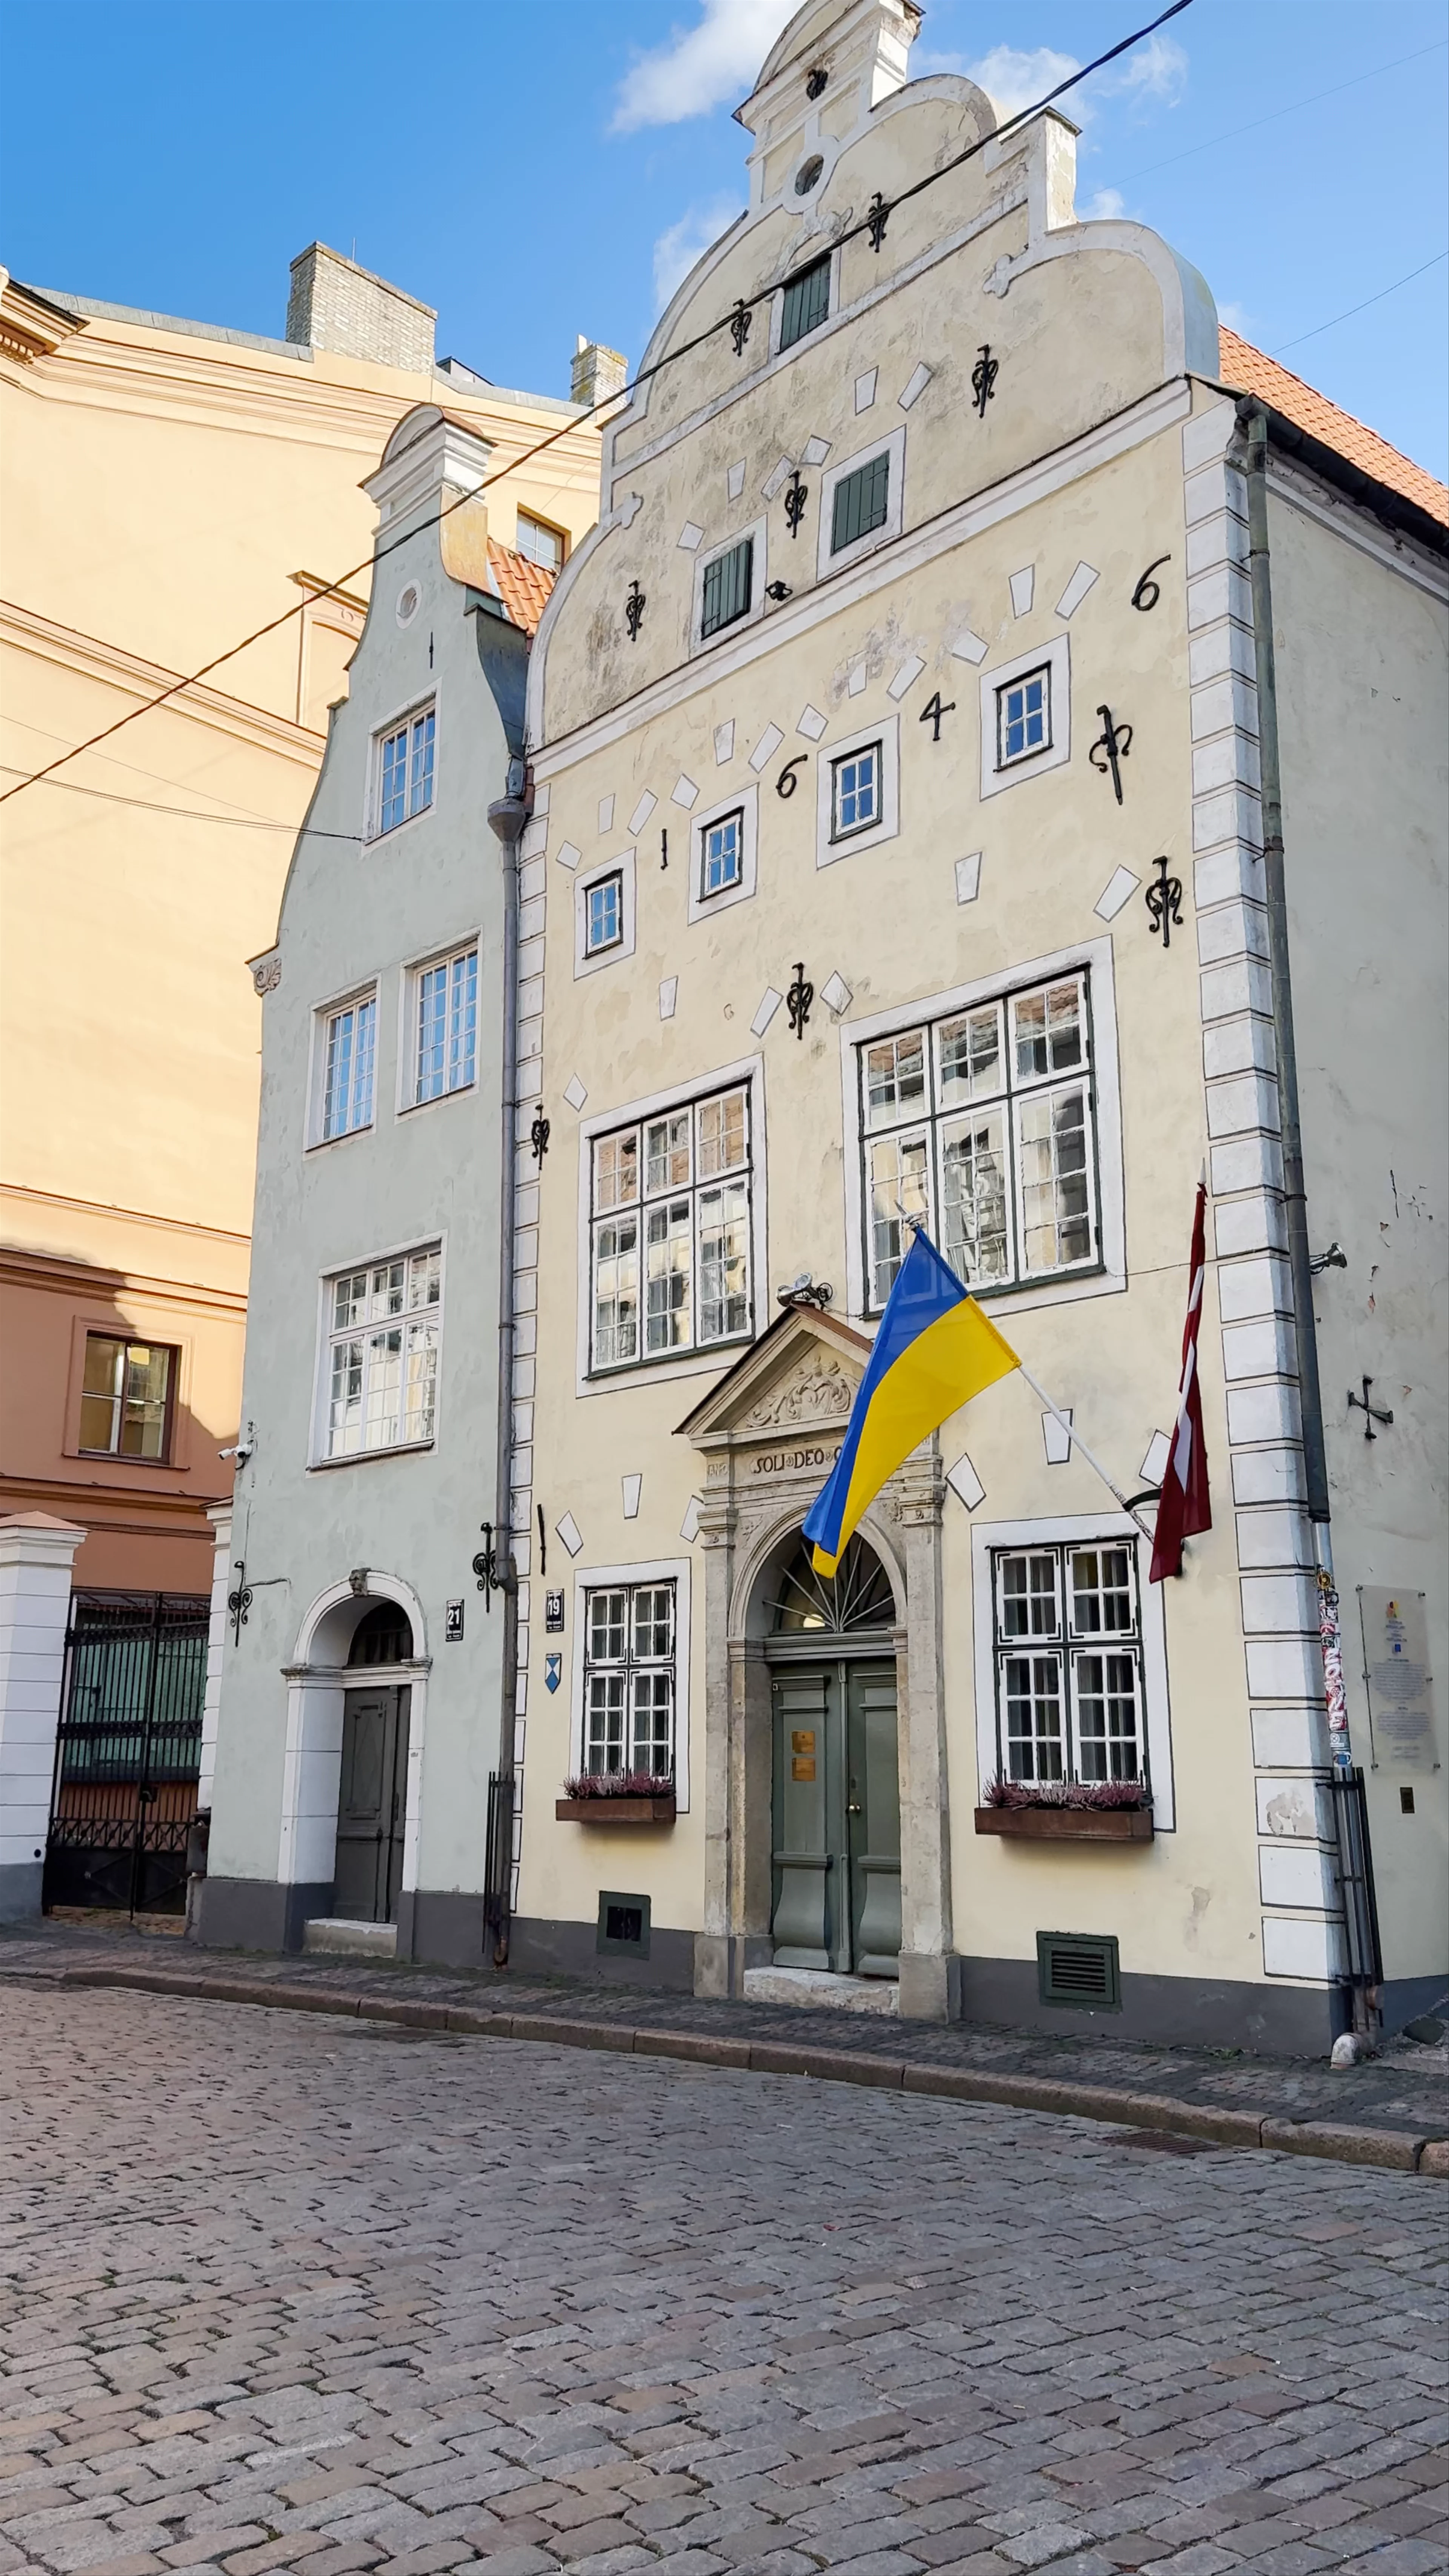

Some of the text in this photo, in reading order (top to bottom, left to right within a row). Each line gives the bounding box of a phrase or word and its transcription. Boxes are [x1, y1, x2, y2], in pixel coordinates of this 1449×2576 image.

[775, 754, 808, 798] 6
[919, 692, 955, 741] 4
[1131, 554, 1171, 611] 6
[754, 1455, 784, 1474] SOLI
[794, 1448, 825, 1469] DEO
[448, 1609, 460, 1625] 21
[548, 1598, 560, 1616] 19
